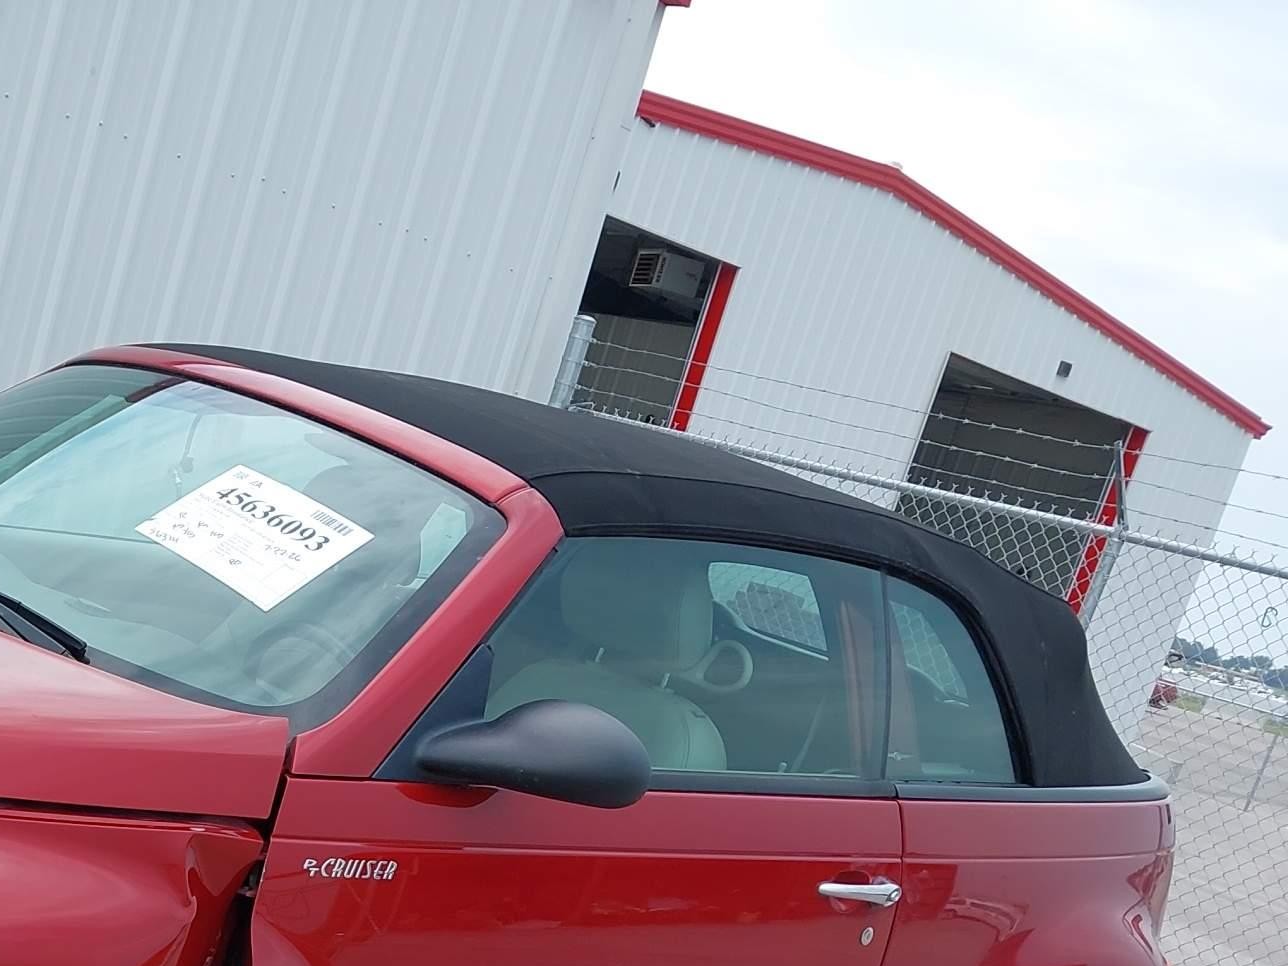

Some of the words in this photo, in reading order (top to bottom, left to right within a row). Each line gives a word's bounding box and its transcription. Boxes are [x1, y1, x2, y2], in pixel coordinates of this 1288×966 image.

[216, 487, 331, 552] 45636093
[303, 858, 320, 877] PT
[321, 857, 398, 880] CRUISER
